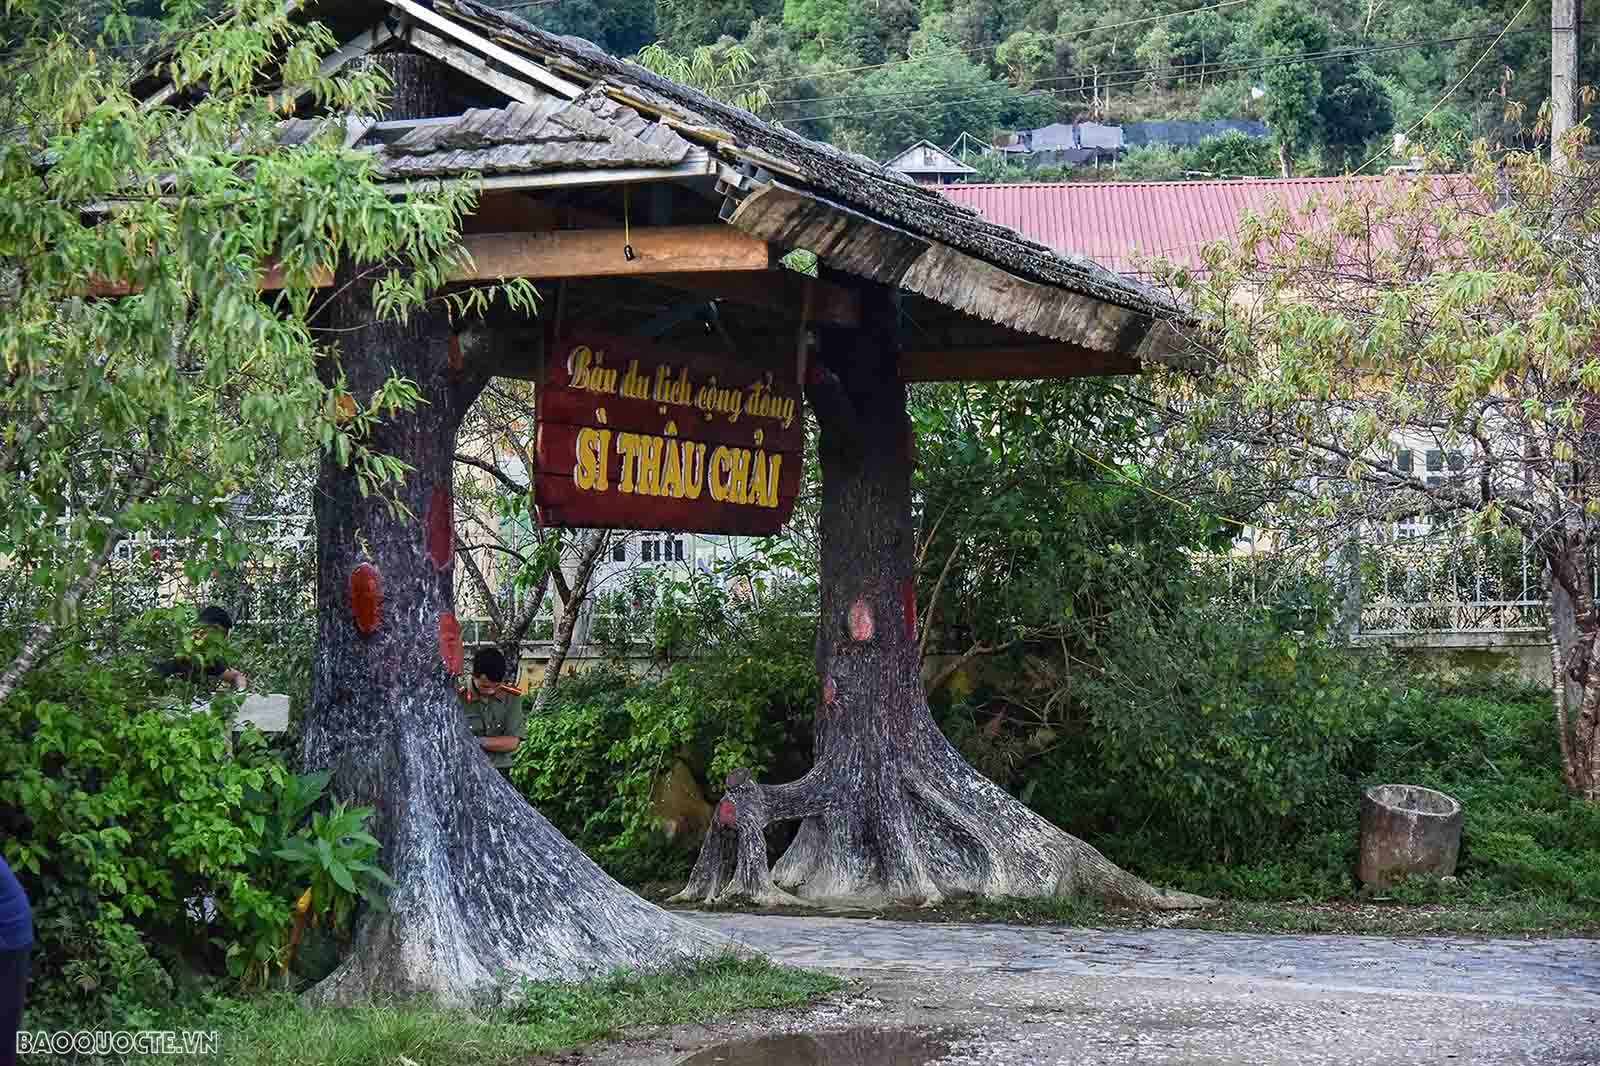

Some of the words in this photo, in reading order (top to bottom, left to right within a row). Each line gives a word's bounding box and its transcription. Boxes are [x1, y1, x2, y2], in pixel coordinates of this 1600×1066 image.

[567, 345, 617, 394] Bản
[621, 359, 649, 400] du
[653, 365, 694, 415] lịch
[694, 376, 743, 424] cộng
[574, 407, 611, 491] SÌ
[617, 421, 706, 499] THÂU
[708, 428, 782, 508] CHẢI
